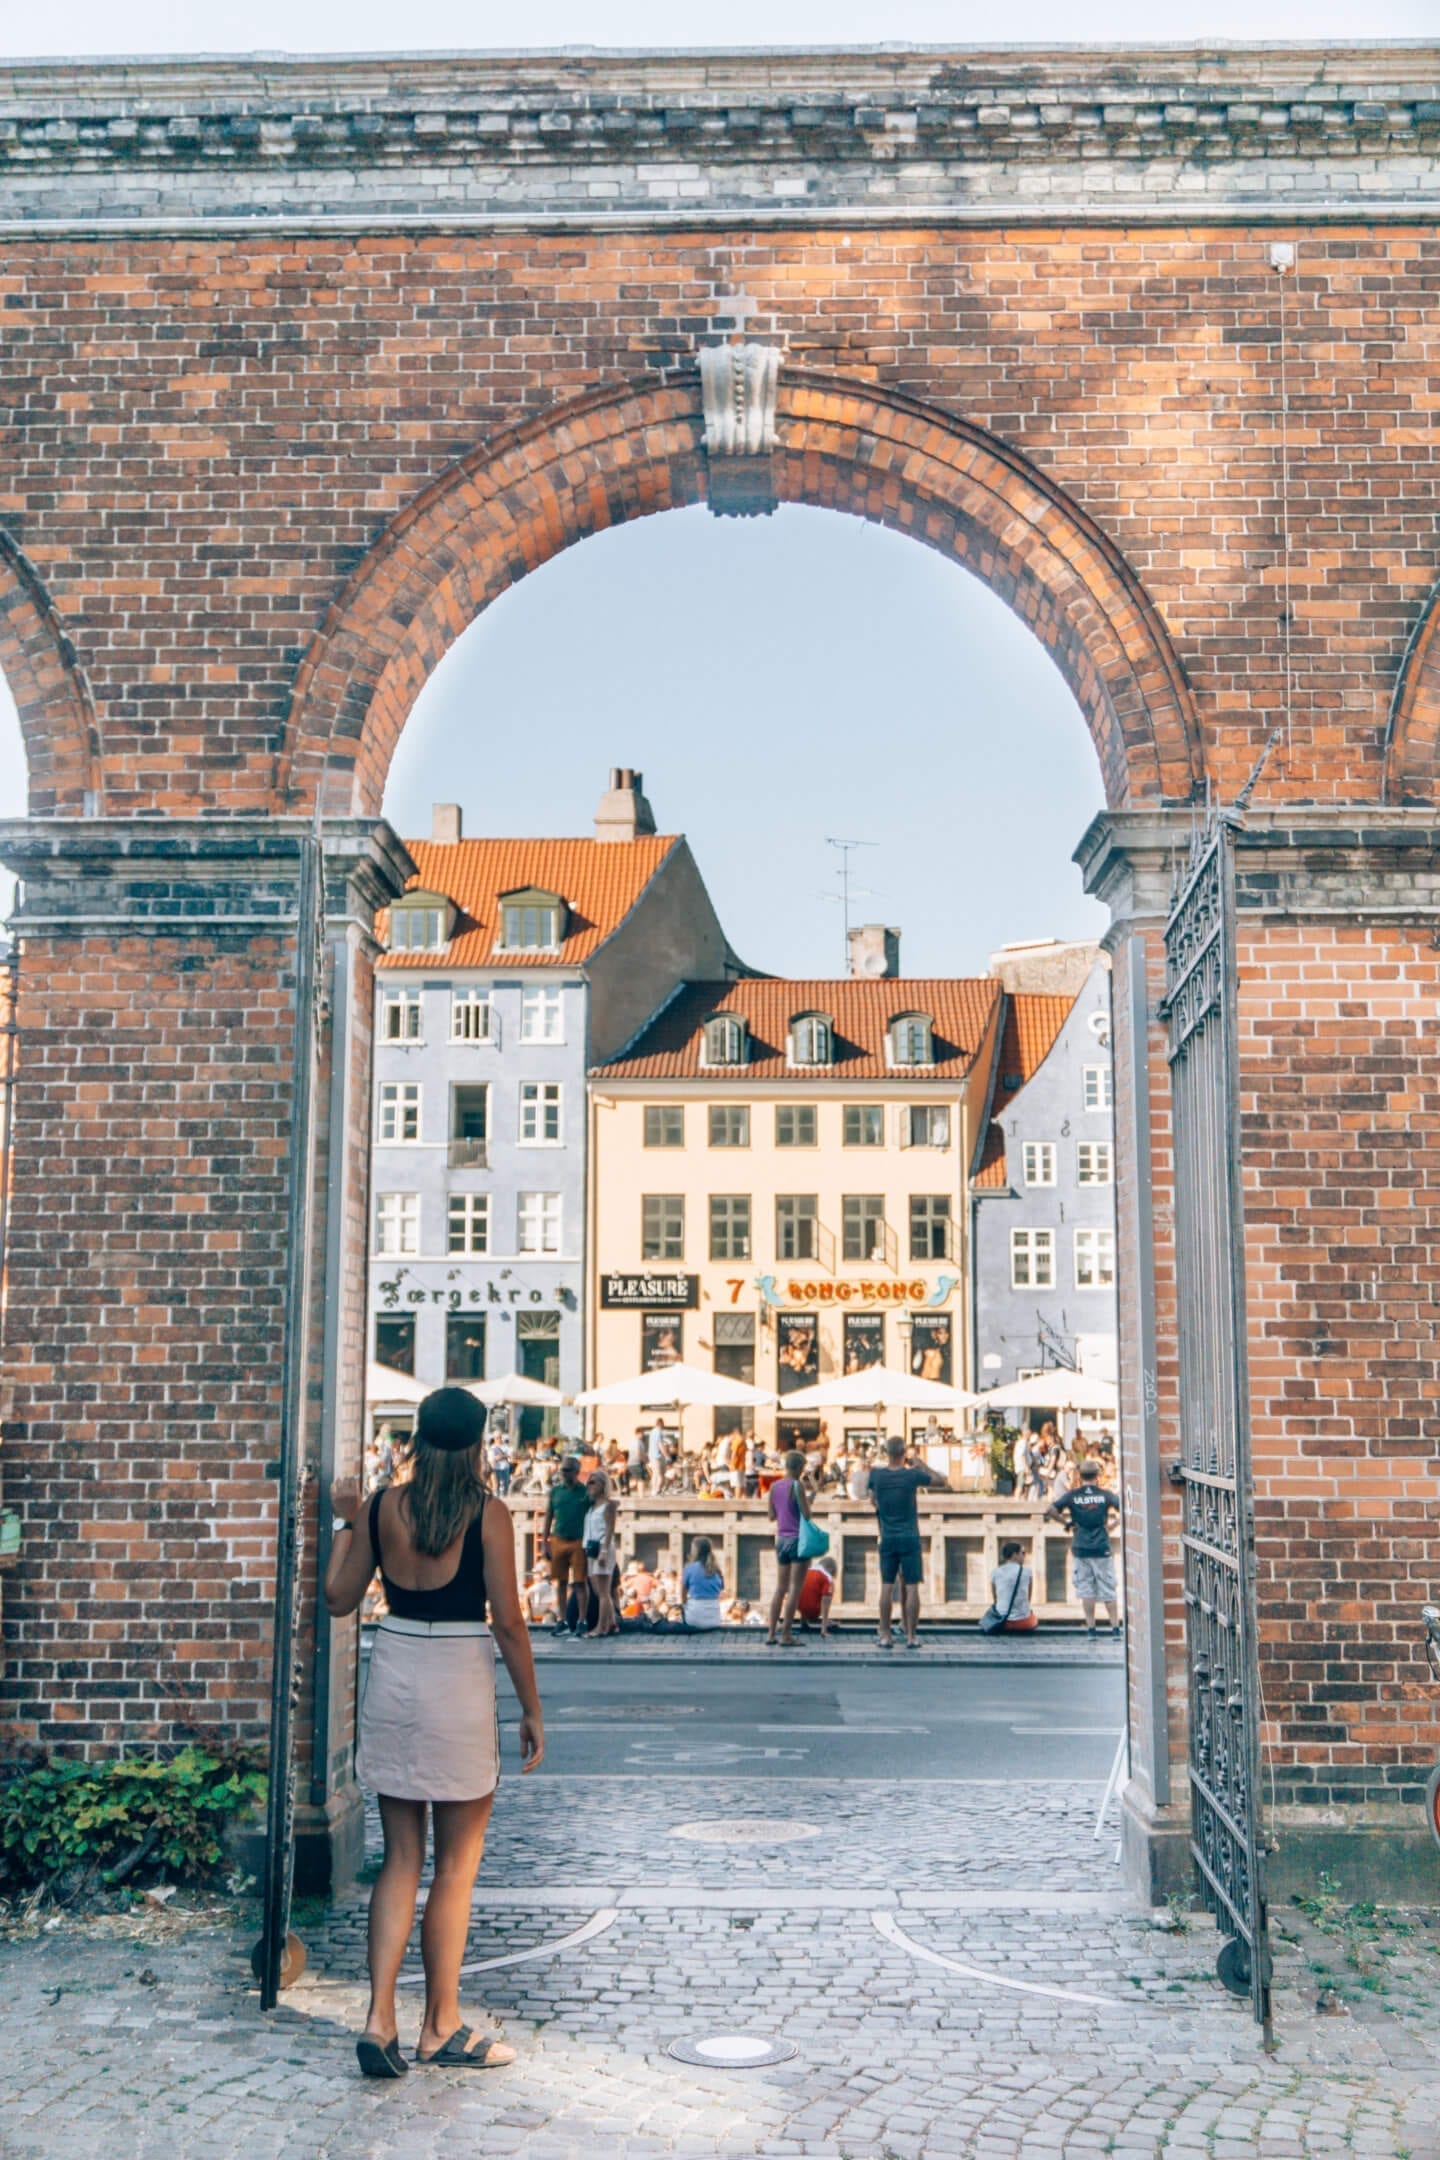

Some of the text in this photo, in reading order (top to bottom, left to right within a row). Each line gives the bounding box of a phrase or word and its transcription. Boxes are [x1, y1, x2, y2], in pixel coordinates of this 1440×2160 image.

[607, 1279, 689, 1297] PLEASURE
[726, 1278, 746, 1304] 7
[788, 1281, 926, 1301] HONG-KONG
[1073, 1494, 1105, 1505] ULSTER
